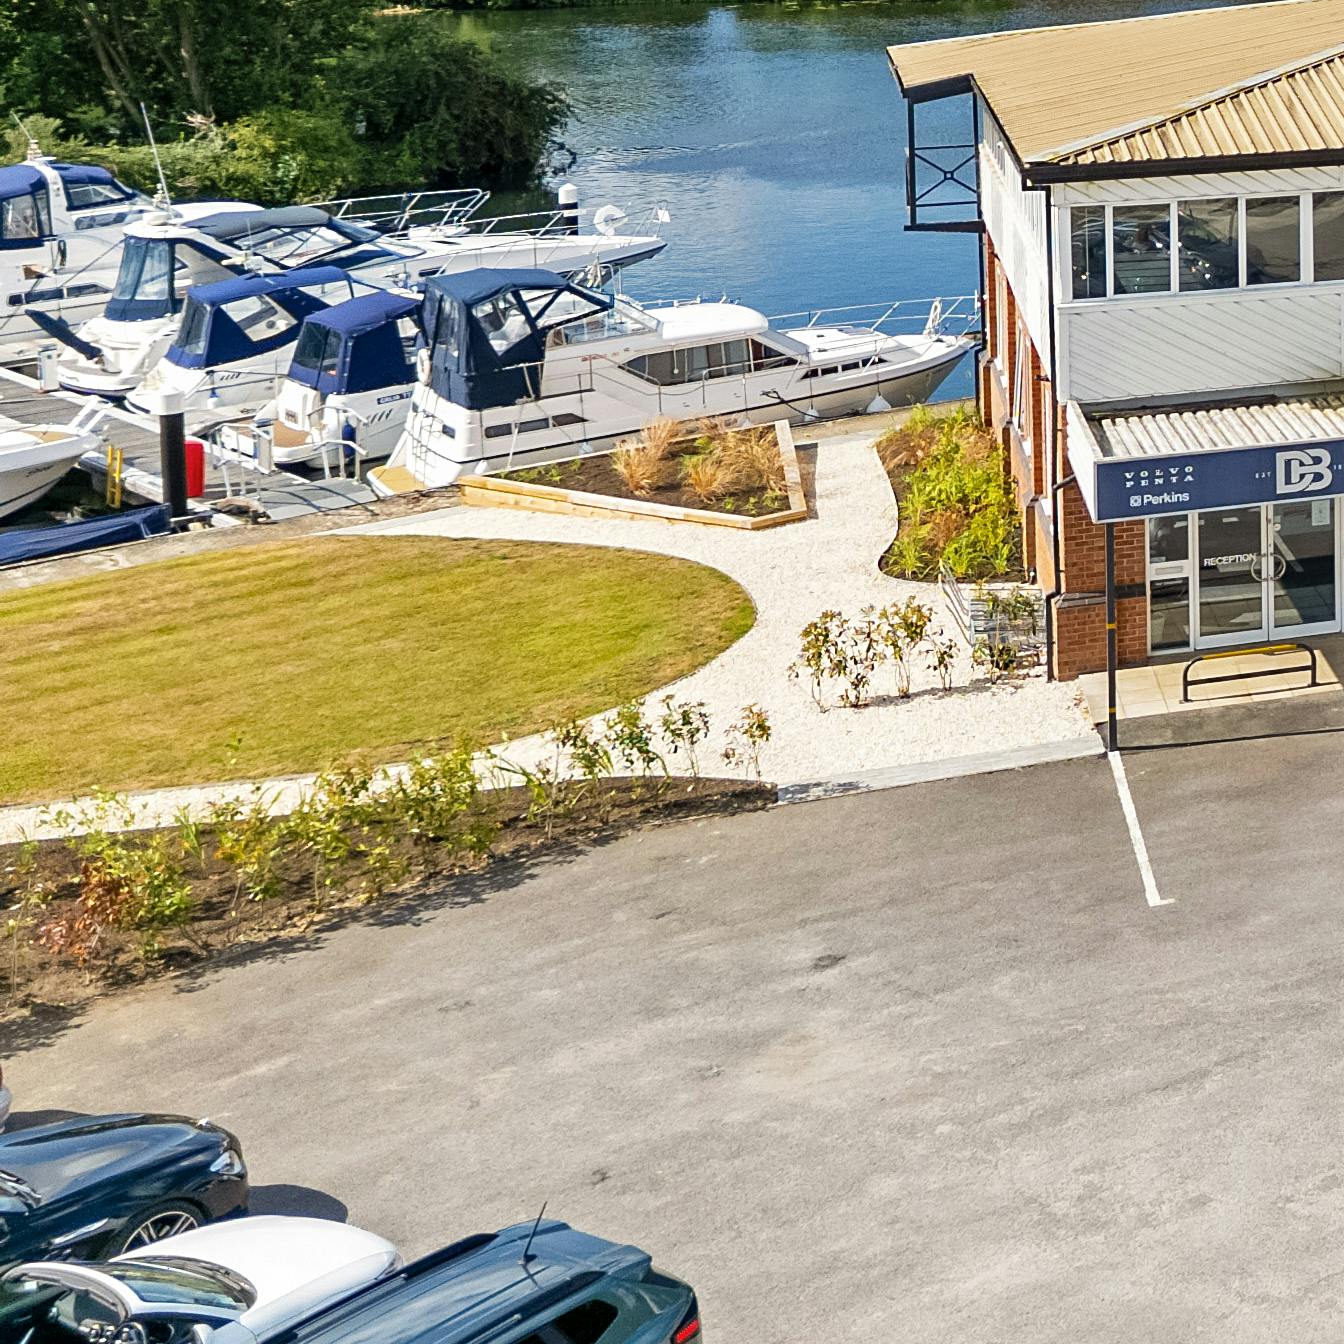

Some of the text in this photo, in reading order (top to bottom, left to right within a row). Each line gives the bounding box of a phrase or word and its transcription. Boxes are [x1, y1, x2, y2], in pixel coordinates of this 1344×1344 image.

[1124, 465, 1194, 479] VOLVO
[1125, 475, 1195, 488] PENTA
[1143, 492, 1190, 506] Perkins
[1203, 552, 1257, 567] RECEPTION
